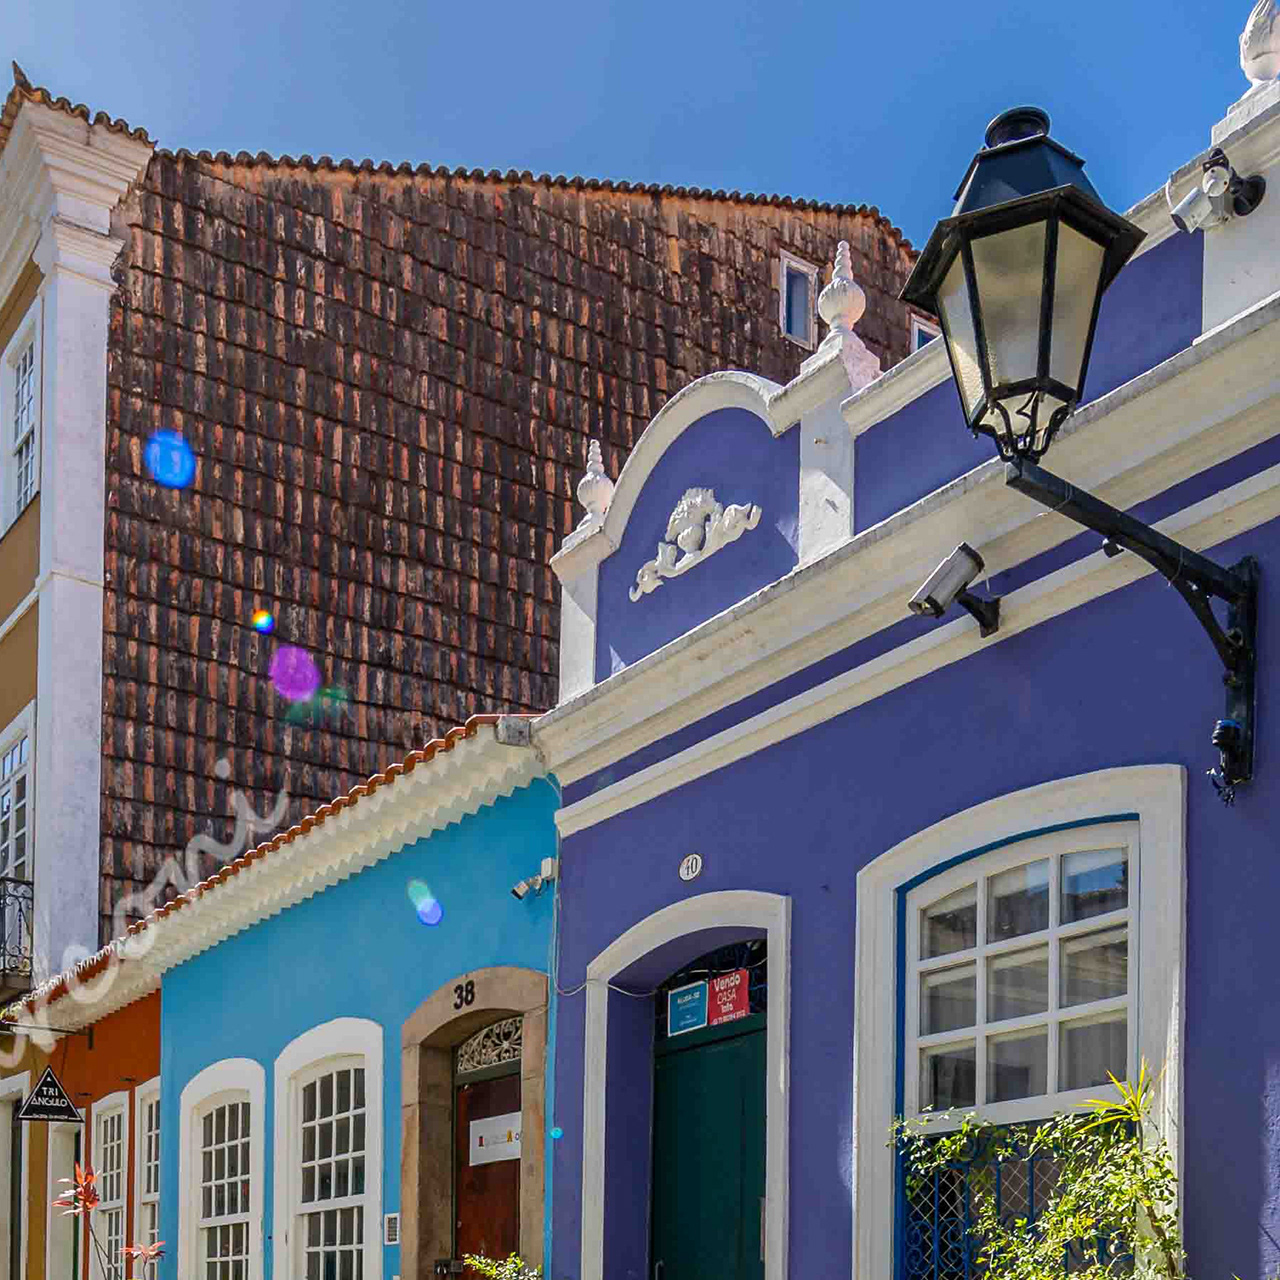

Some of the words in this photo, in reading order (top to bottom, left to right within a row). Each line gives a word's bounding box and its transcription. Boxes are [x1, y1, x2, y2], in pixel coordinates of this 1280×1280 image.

[713, 972, 741, 991] Vendo
[453, 979, 475, 1010] 38
[717, 988, 737, 1005] CASA
[41, 1086, 58, 1096] TRI
